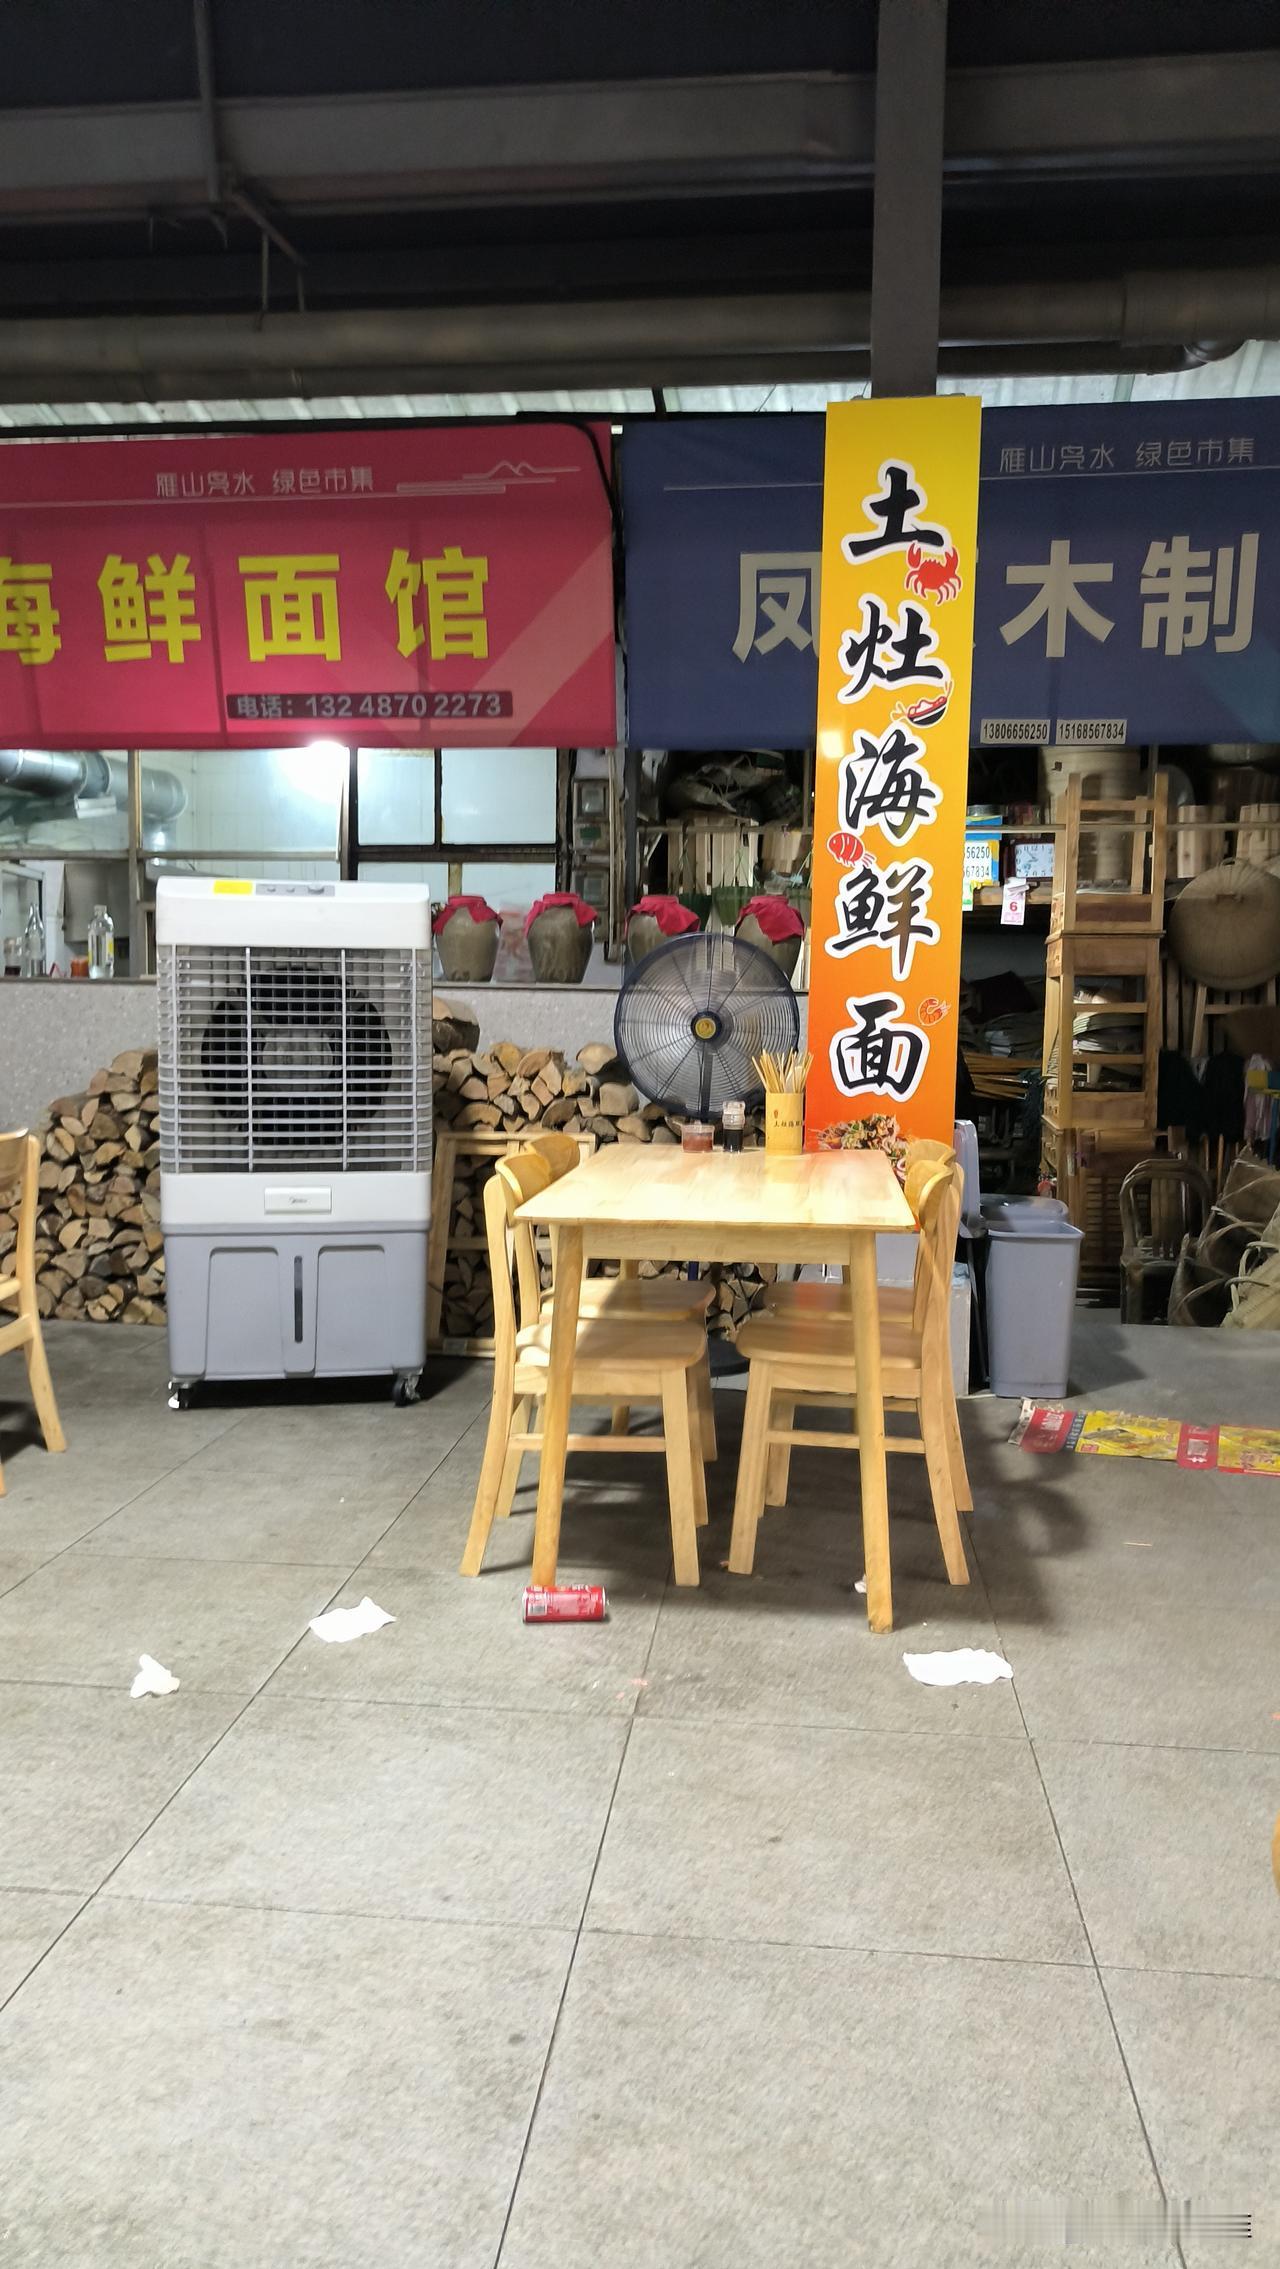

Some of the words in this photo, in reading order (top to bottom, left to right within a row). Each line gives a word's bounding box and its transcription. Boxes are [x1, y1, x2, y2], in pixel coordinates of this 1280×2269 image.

[1135, 437, 1255, 467] 绿色市集
[272, 466, 374, 494] 绿色市集
[732, 533, 1259, 663] 凤木制
[305, 696, 352, 717] 132
[360, 695, 427, 717] 4870
[434, 694, 501, 716] 2273
[983, 723, 1048, 740] 13806656250
[1059, 722, 1125, 739] 15168567834
[832, 465, 945, 1095] 土灶海鲜面
[964, 846, 990, 859] 56250
[963, 866, 990, 878] 67834
[1009, 901, 1018, 912] 6
